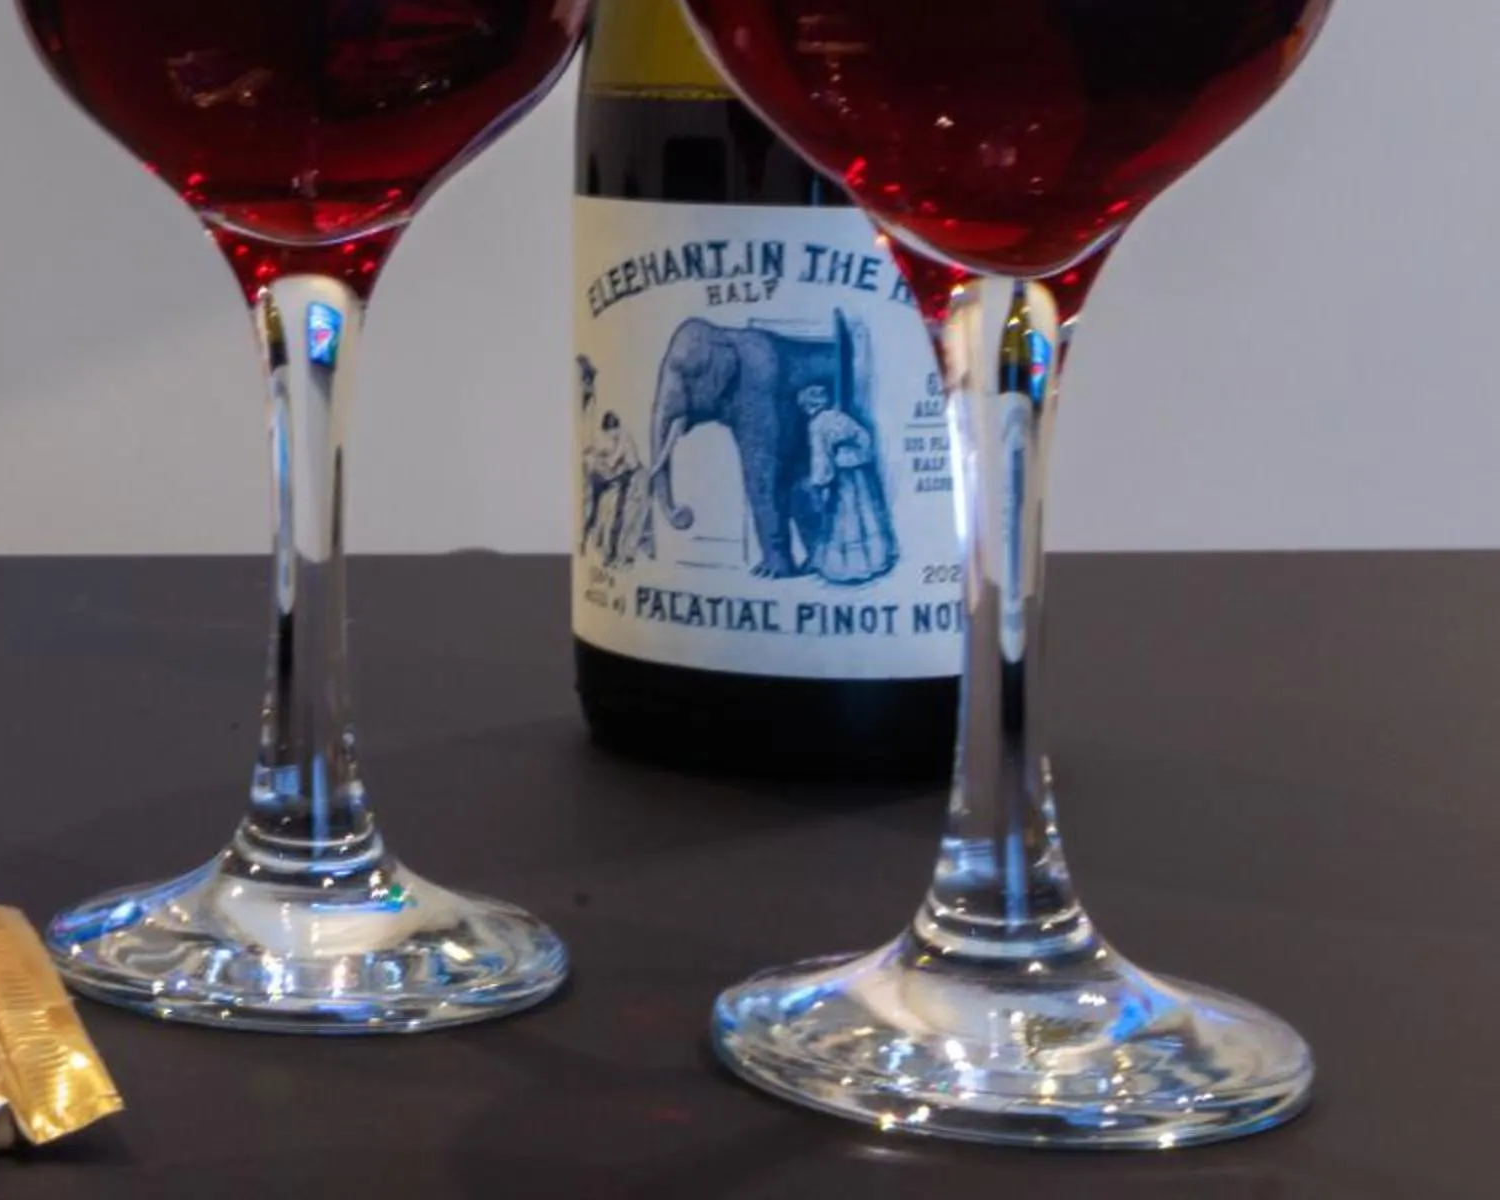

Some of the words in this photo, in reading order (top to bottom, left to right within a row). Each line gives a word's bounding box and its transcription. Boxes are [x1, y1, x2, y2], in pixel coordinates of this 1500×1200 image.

[587, 239, 728, 318] ELEPHANT
[744, 240, 784, 277] IN
[798, 243, 882, 291] THE
[706, 277, 779, 306] HALF
[923, 565, 960, 584] 202
[636, 586, 781, 632] PALATIAL
[795, 603, 899, 635] PINOT
[913, 603, 963, 635] NOI
